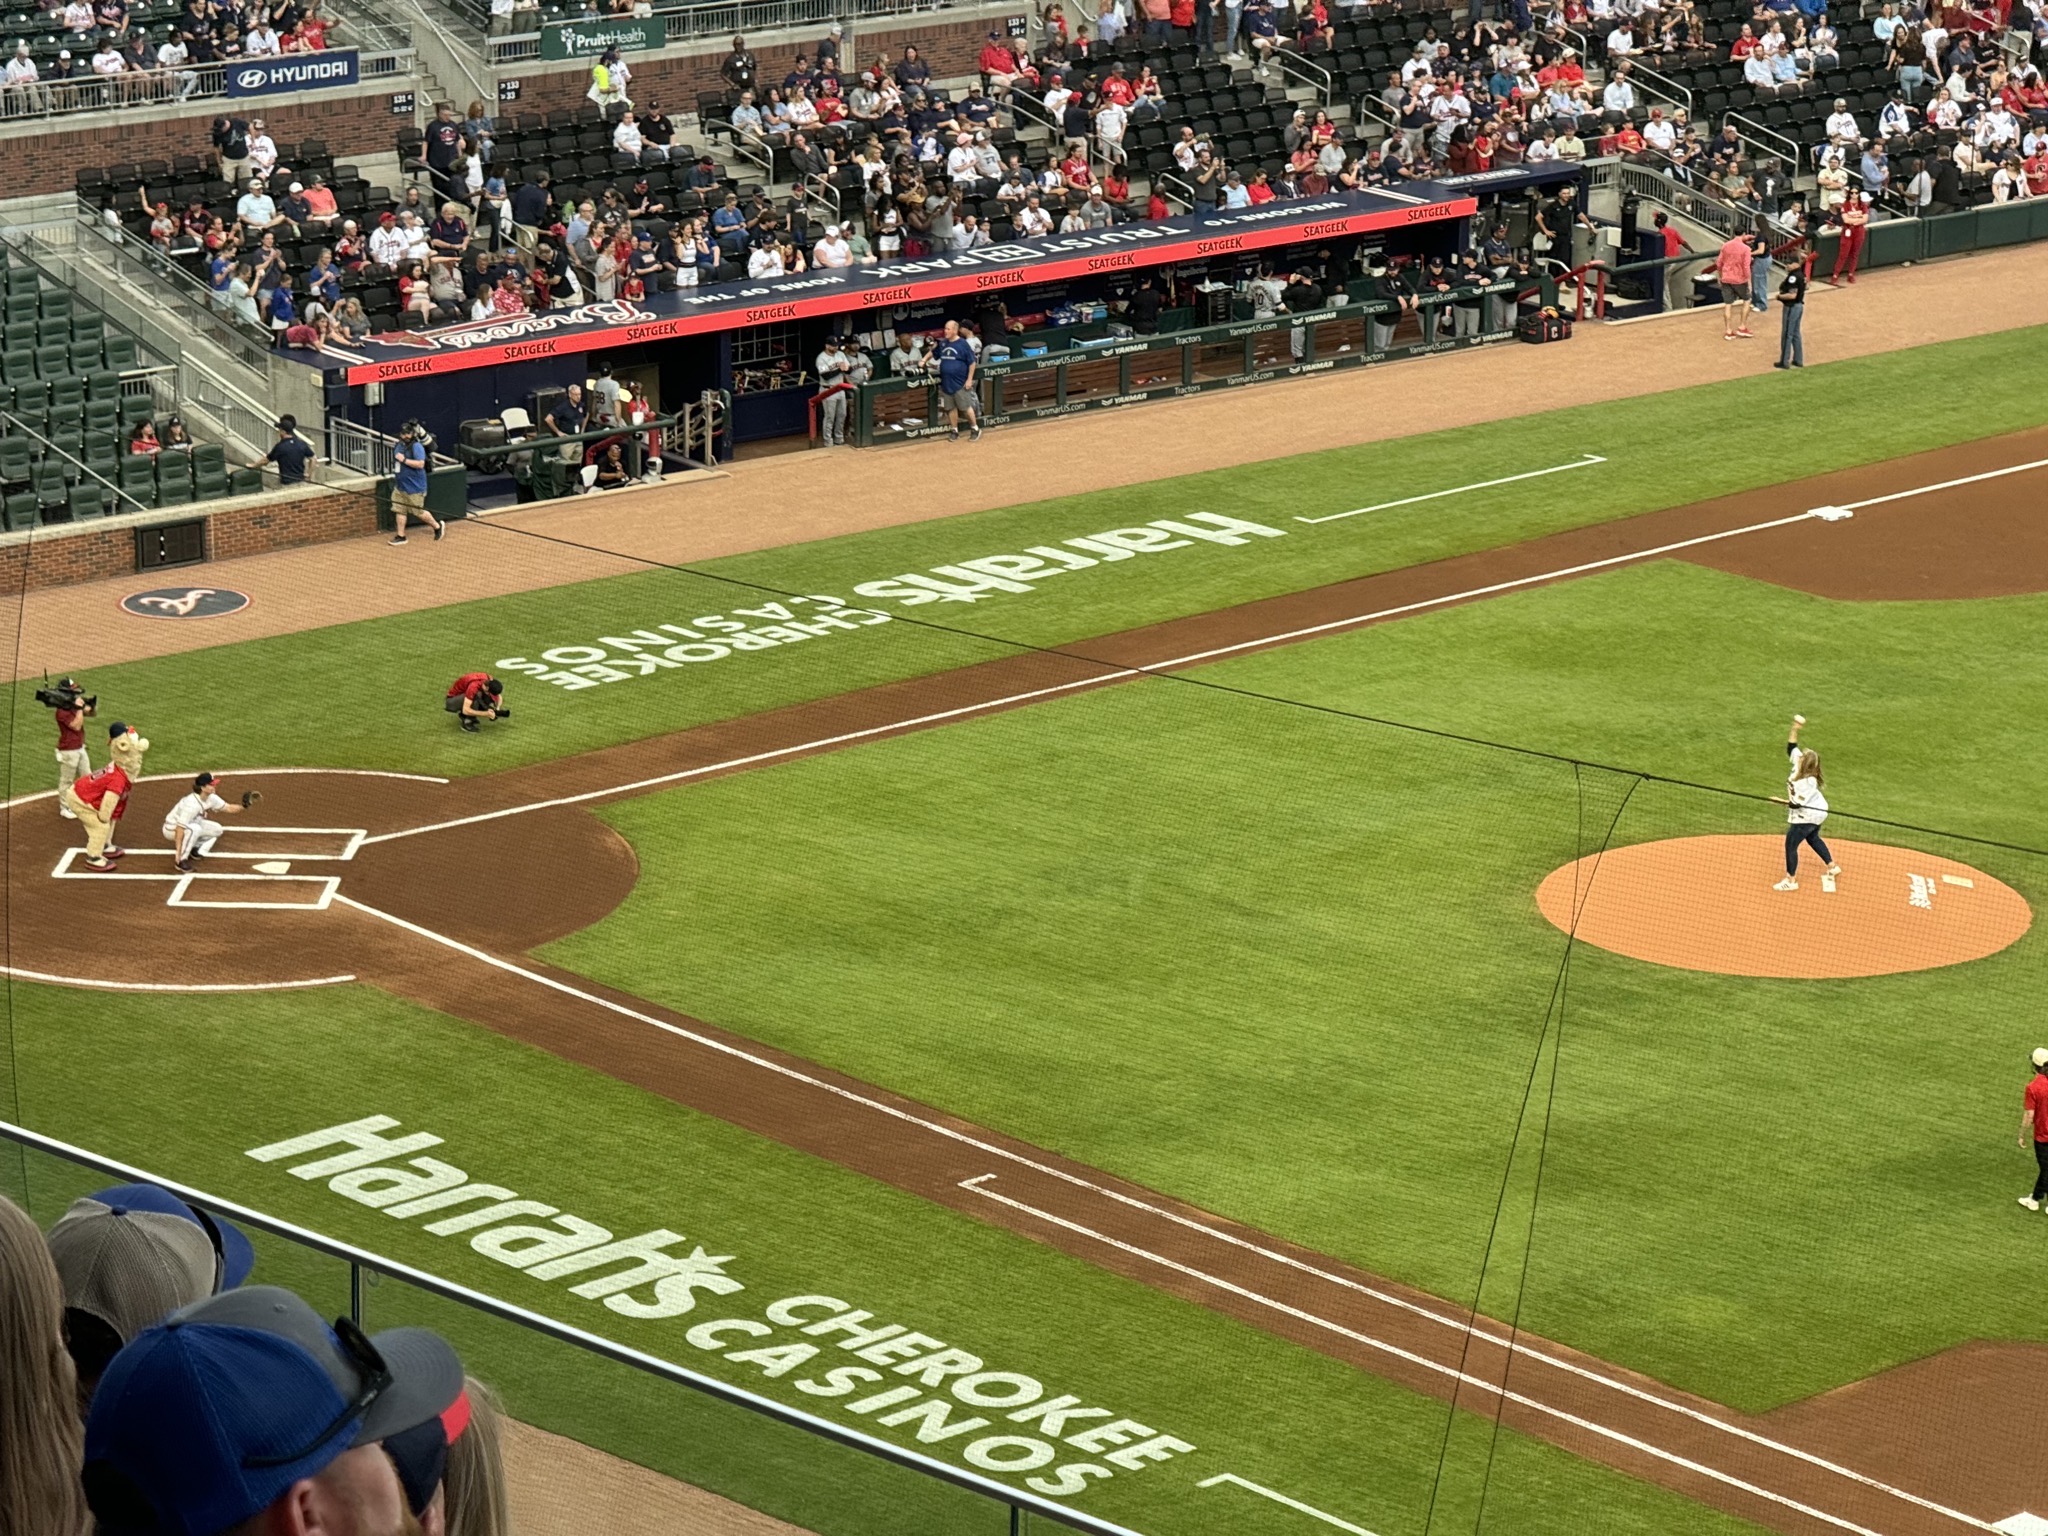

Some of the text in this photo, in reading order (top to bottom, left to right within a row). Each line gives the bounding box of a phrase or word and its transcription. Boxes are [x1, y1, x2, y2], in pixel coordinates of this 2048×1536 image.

[576, 27, 646, 48] PruittHealth
[270, 60, 349, 84] HYUNDAI
[1203, 201, 1349, 227] WELCOME TO
[1407, 203, 1452, 221] SEATGEEK
[1303, 219, 1349, 238] SEATGEEK
[861, 225, 1191, 279] TRUIST PARK
[1196, 236, 1244, 255] SEATGEEK
[1087, 252, 1136, 271] SEATGEEK
[976, 269, 1026, 289] SEATGEEK
[1484, 281, 1516, 293] YANMAR
[683, 275, 846, 305] HOME OF THE
[862, 286, 912, 306] SEATGEEK
[746, 304, 796, 323] SEATGEEK
[1304, 311, 1337, 323] YANMAR
[1362, 303, 1389, 314] Tractors
[438, 298, 657, 349] Braves
[626, 322, 679, 341] SEATGEEK
[1229, 322, 1278, 337] YanmarUS.com
[1175, 334, 1202, 346] Tractors
[1482, 330, 1515, 342] YANMAR
[503, 340, 557, 360] SEATGEEK
[1114, 342, 1148, 354] YANMAR
[1409, 341, 1456, 354] YanmarUS.com
[1036, 354, 1087, 369] YanmarUS.com
[1301, 360, 1334, 372] YANMAR
[1360, 352, 1386, 363] Tractors
[378, 358, 432, 378] SEATGEEK
[983, 366, 1011, 377] Tractors
[1226, 370, 1275, 386] YanmarUS.com
[1114, 392, 1148, 404] YANMAR
[1174, 384, 1201, 395] Tractors
[1035, 402, 1086, 417] YanmarUS.com
[983, 415, 1011, 427] Tractors
[494, 594, 848, 675] CASINOS
[544, 606, 892, 692] CHEROKEE
[765, 1294, 1198, 1471] CHEROKEE
[685, 1318, 1114, 1497] CASINOS
